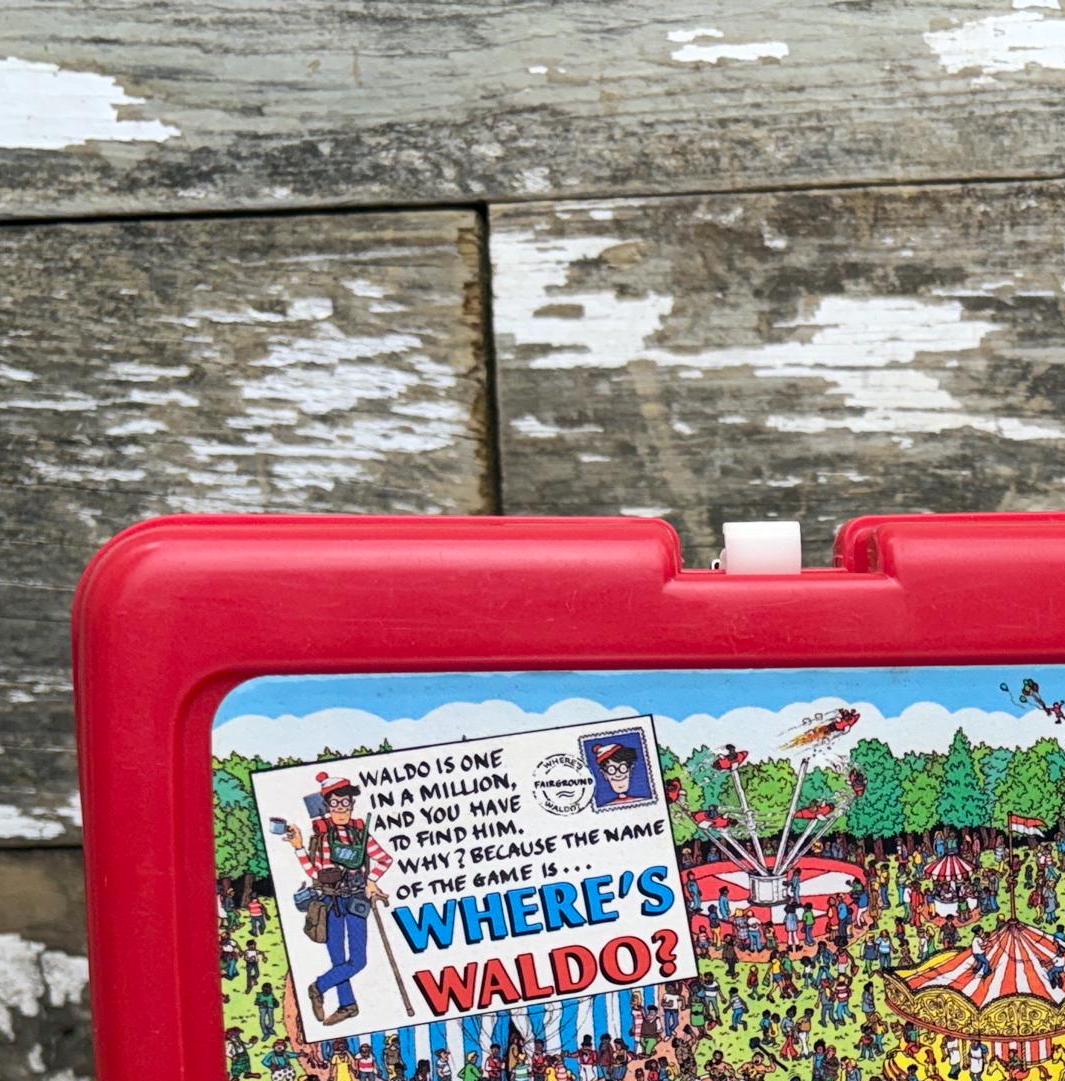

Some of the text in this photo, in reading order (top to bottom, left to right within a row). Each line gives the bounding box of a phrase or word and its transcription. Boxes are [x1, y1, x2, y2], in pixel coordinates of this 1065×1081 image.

[359, 748, 504, 787] WALDO IS ONE
[534, 777, 593, 789] FAIRGROUND
[370, 773, 517, 809] IN A MILLION,
[374, 795, 521, 832] AND YOU HAVE
[389, 820, 525, 852] TO FIND HIM.
[470, 835, 557, 864] BECAUSE
[562, 828, 600, 849] THE
[603, 819, 665, 843] NAME
[396, 881, 424, 900] OF
[428, 874, 467, 895] THE
[473, 863, 533, 887] GAME
[391, 865, 676, 953] WHERE'S
[412, 928, 679, 1017] WALDO?
